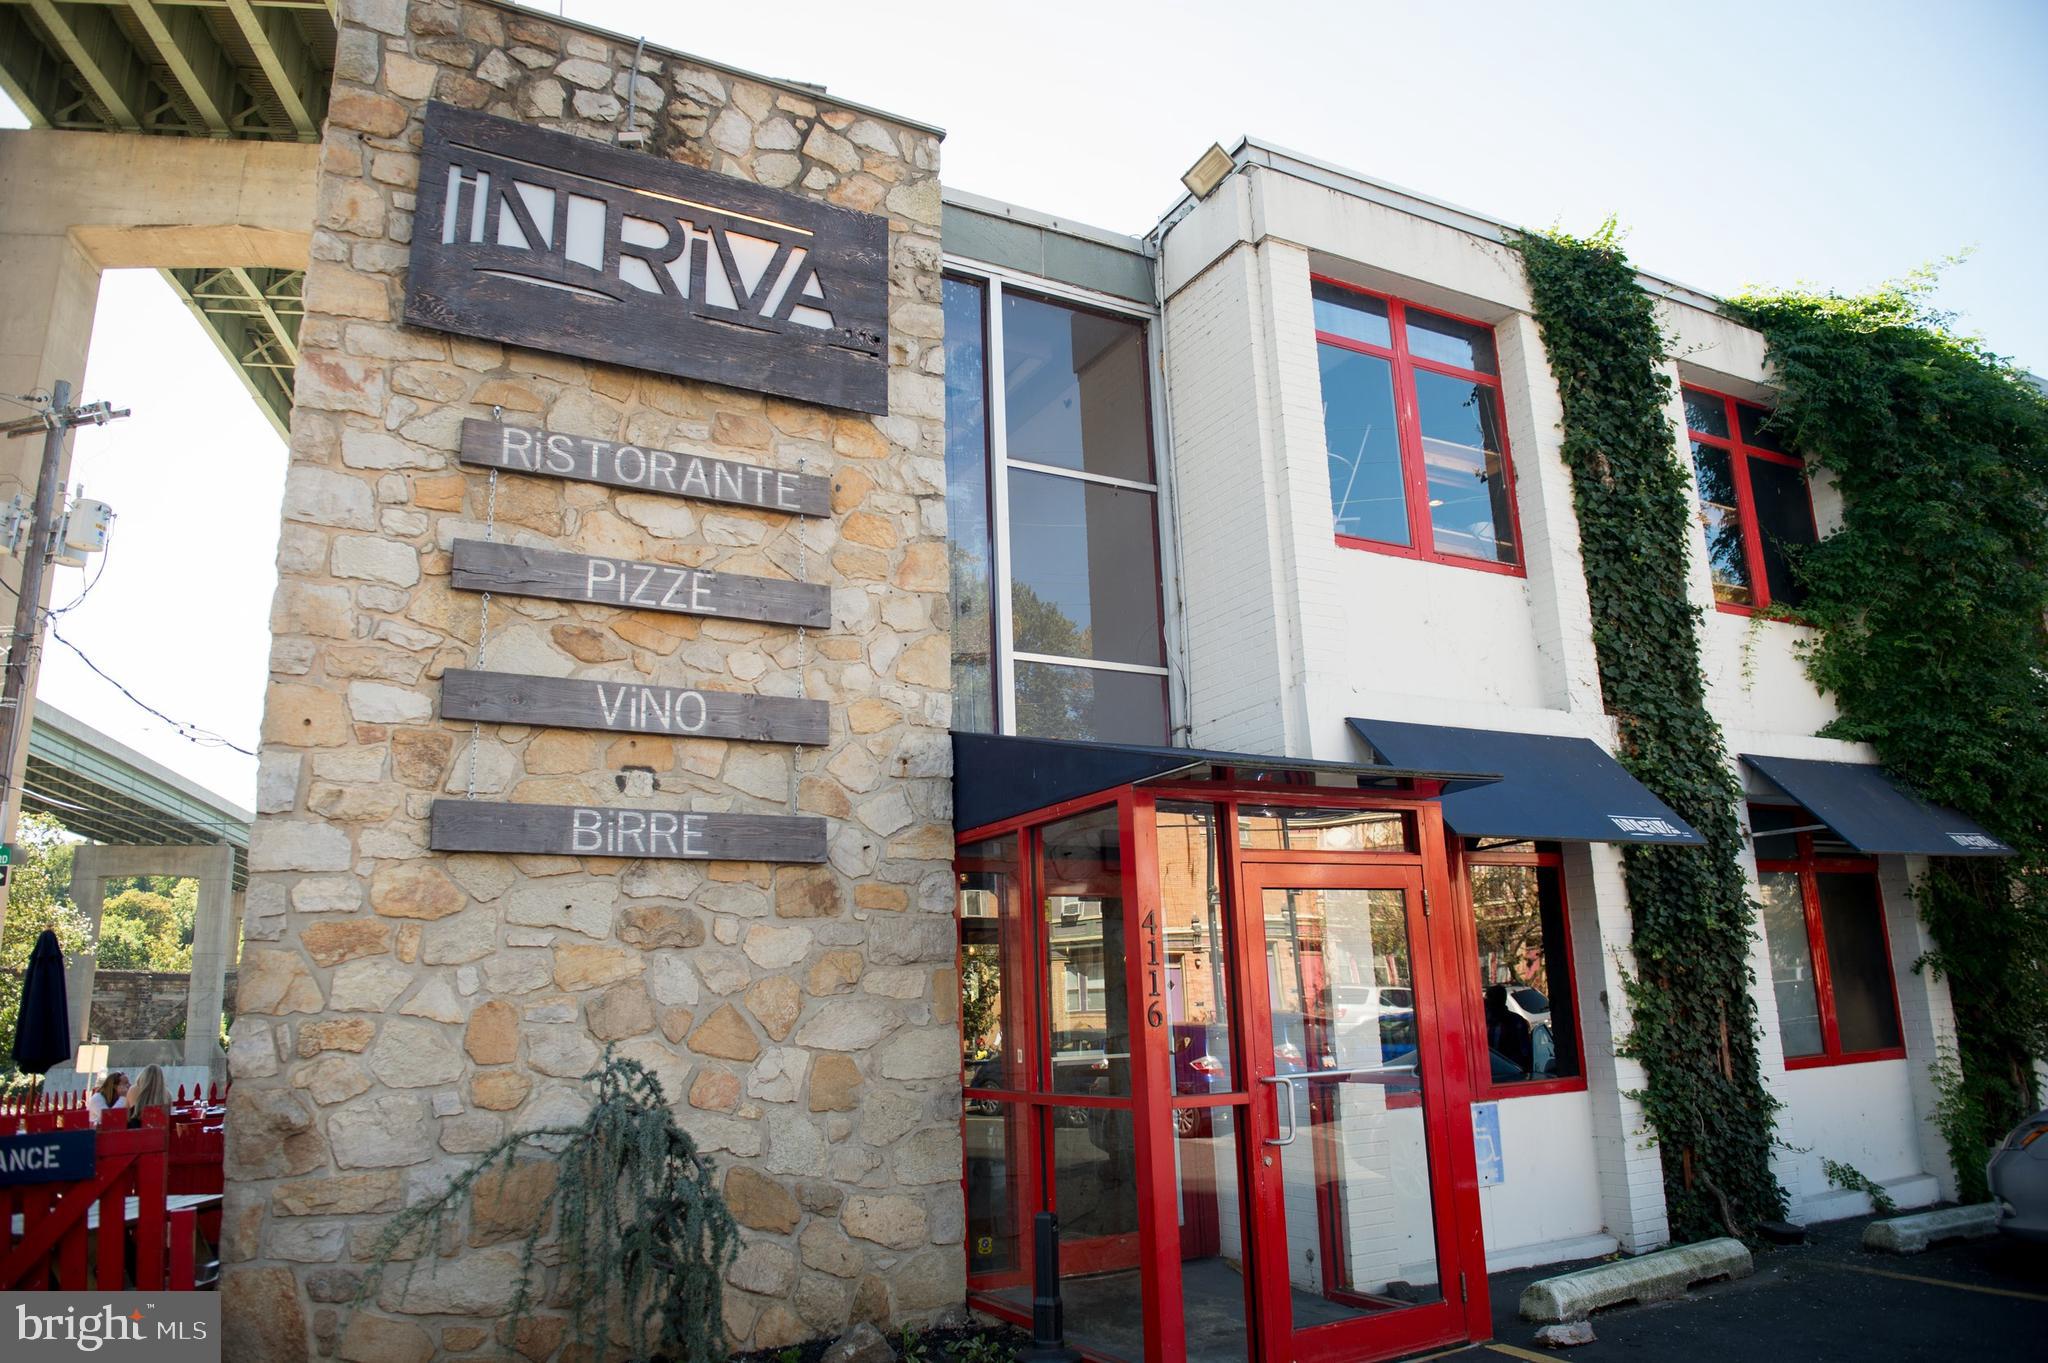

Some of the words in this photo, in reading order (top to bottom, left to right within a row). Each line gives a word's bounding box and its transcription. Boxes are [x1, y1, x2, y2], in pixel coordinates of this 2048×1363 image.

[502, 427, 802, 509] RiSTORANTE
[587, 559, 717, 612] PiZZE
[597, 684, 706, 731] ViNO
[572, 809, 709, 855] BiRRE
[1142, 910, 1163, 1028] 4116
